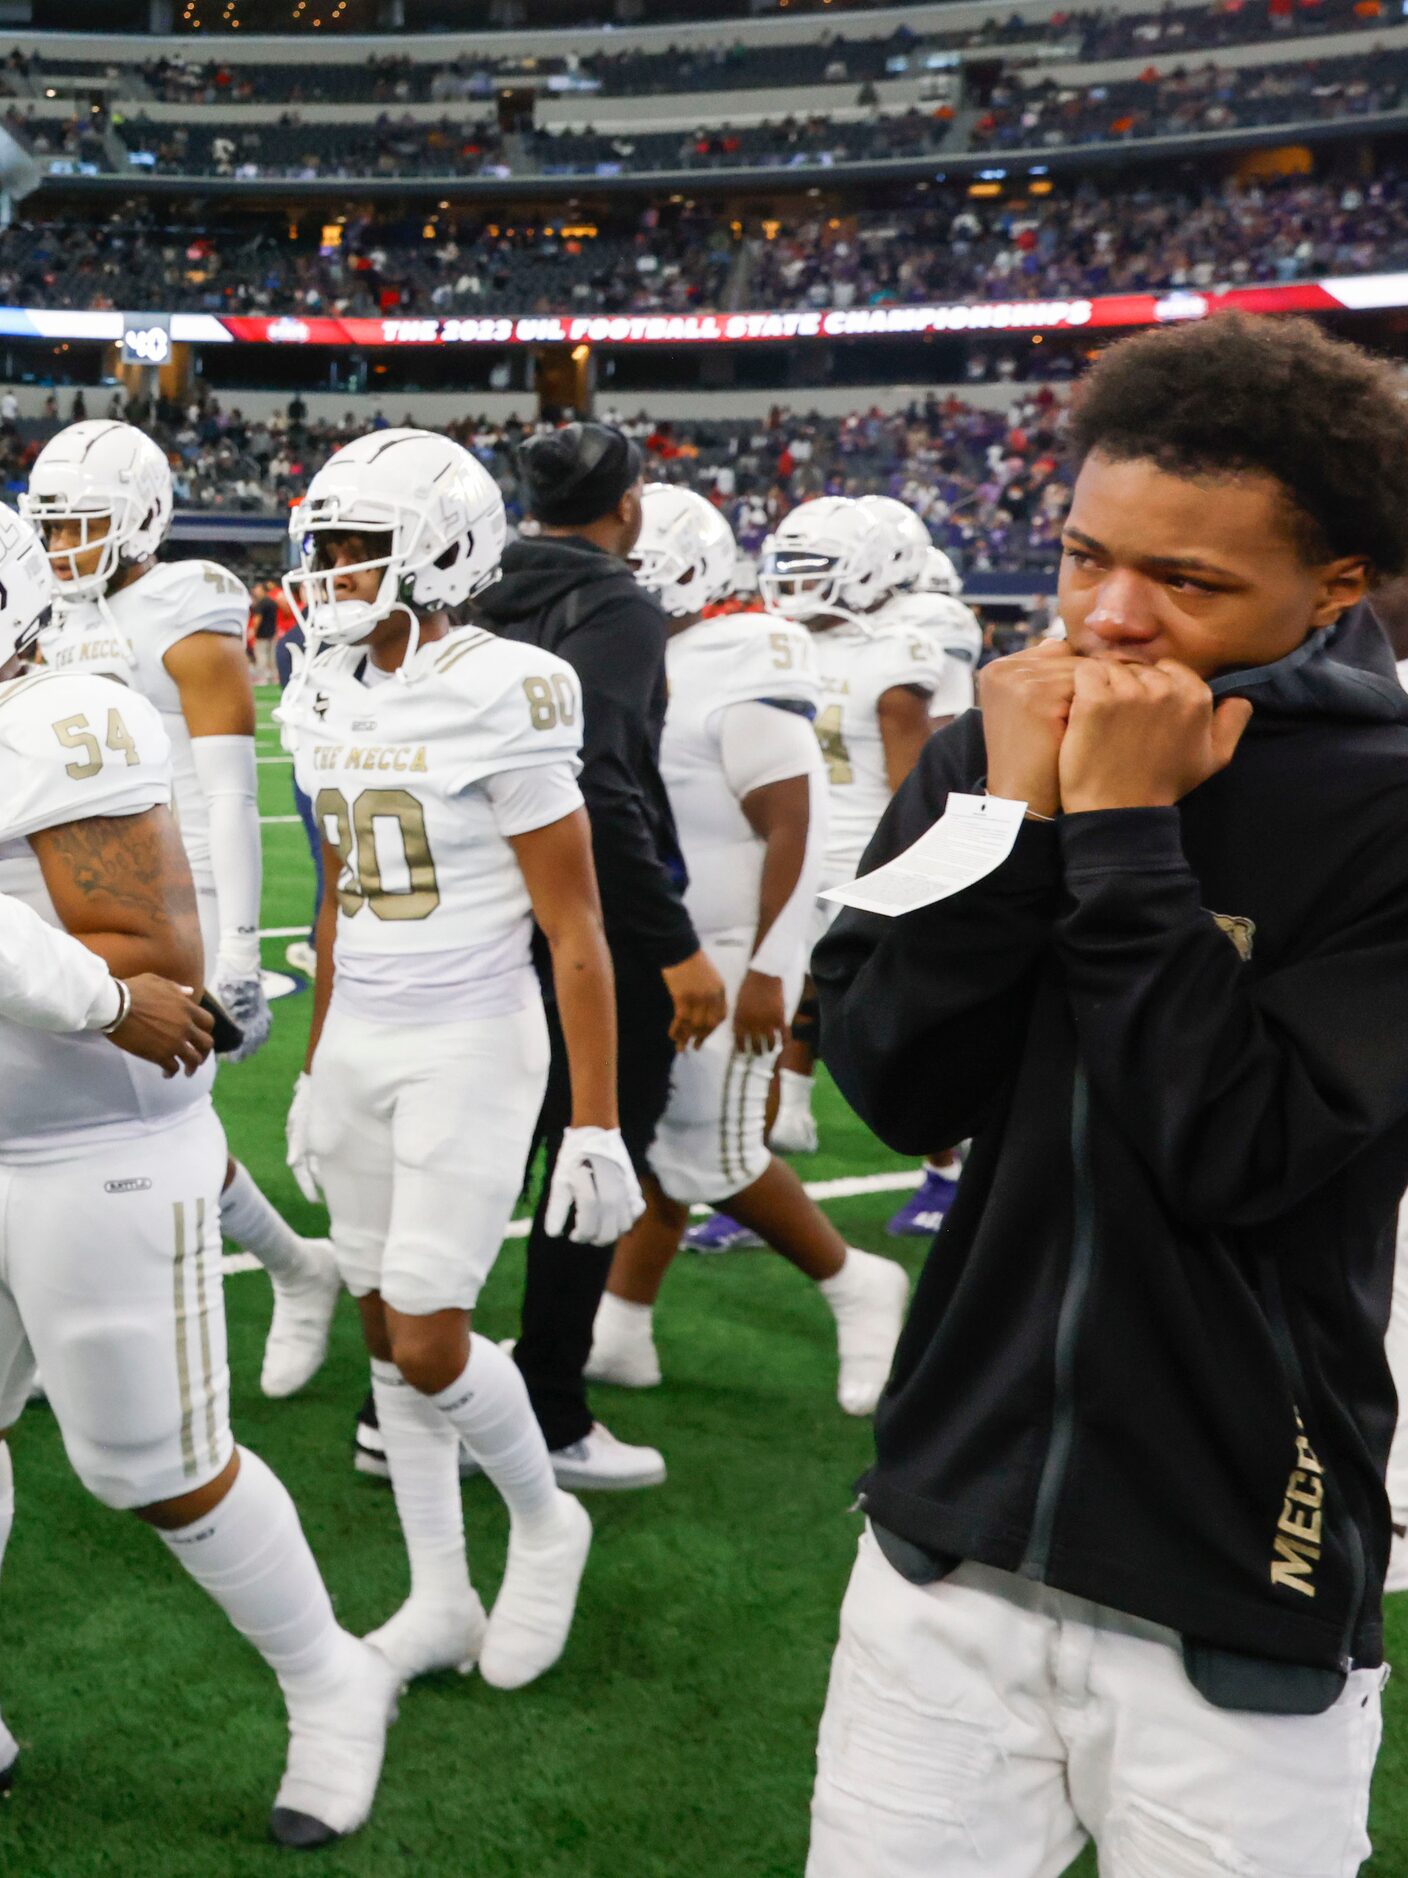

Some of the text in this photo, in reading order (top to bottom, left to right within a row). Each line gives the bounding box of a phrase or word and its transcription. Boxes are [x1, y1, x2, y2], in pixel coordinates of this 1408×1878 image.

[381, 300, 1093, 343] THE 2023 UIL FOOTBALL STATE CHAMPIONSHIPS
[523, 673, 575, 731] 80
[51, 708, 140, 781] 54
[344, 746, 428, 772] MECCA
